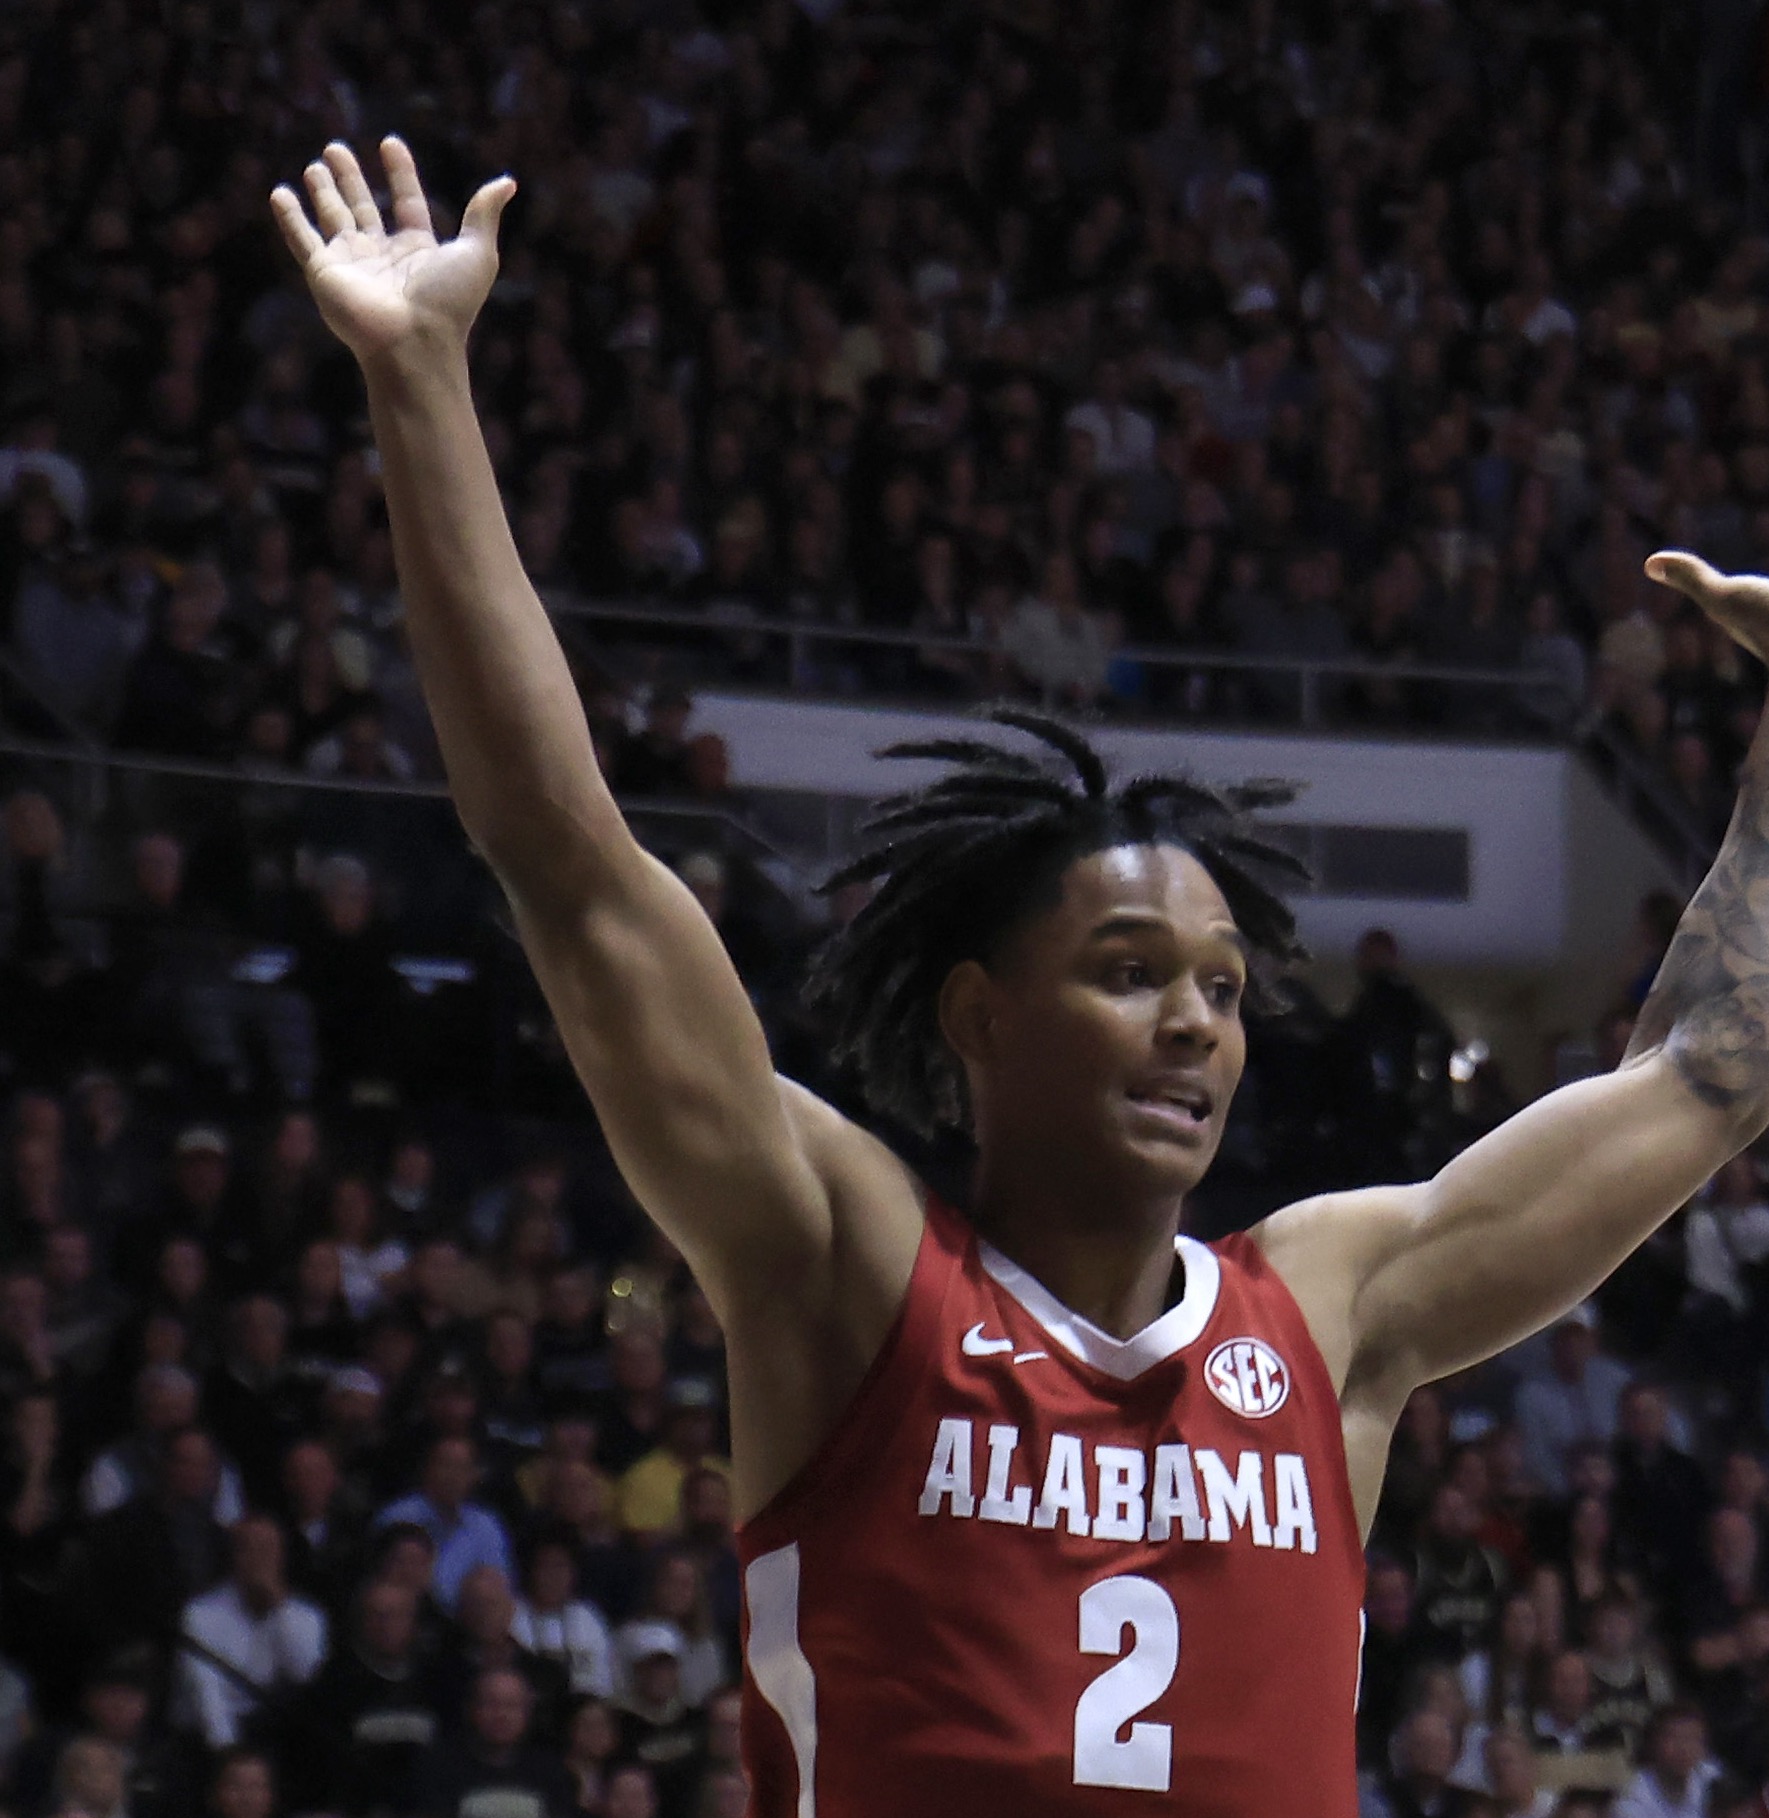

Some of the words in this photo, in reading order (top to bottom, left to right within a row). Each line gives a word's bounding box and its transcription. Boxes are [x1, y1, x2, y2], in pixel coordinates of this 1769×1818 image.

[1211, 1351, 1285, 1415] SEC
[918, 1418, 1318, 1555] ALABAMA
[1072, 1574, 1180, 1792] 2
